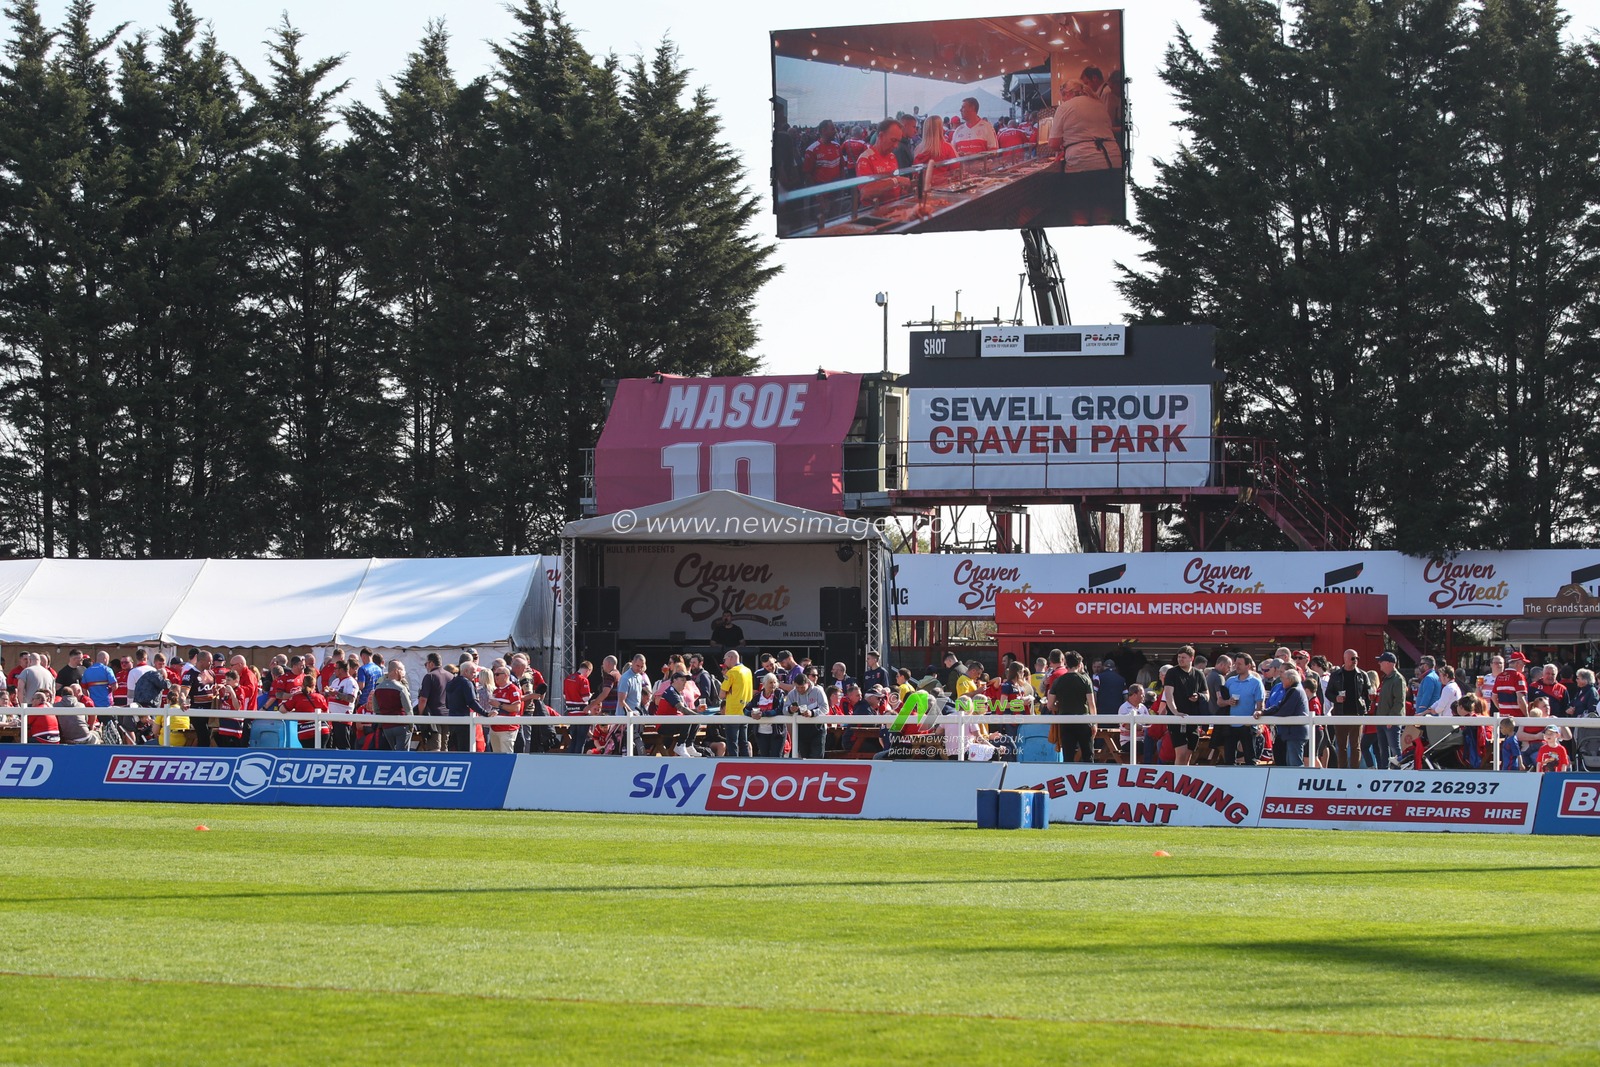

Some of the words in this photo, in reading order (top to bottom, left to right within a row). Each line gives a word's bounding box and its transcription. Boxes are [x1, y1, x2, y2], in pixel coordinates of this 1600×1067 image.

[924, 338, 946, 355] SHOT
[984, 335, 1020, 343] POLAR
[1084, 334, 1120, 342] POLAR
[660, 382, 809, 430] MASOE
[929, 396, 1062, 422] SEWELL
[1071, 394, 1189, 420] GROUP
[929, 426, 1078, 454] CRAVEN
[1090, 424, 1188, 453] PARK
[638, 546, 675, 554] PRESENTS
[673, 552, 774, 588] Craven
[954, 559, 1021, 585] Craven
[1184, 558, 1253, 584] Craven
[1424, 557, 1496, 583] Craven
[681, 582, 790, 622] Streat
[1428, 578, 1509, 609] Streat
[1075, 602, 1144, 615] OFFICIAL
[1149, 601, 1262, 615] MERCHANDISE
[1525, 603, 1541, 612] The
[1546, 602, 1600, 612] Grandstand
[116, 760, 230, 782] BETFRED
[277, 762, 355, 784] SUPER
[359, 765, 464, 788] LEAGUE
[629, 764, 706, 807] sky
[717, 772, 859, 807] sports
[1298, 779, 1347, 792] HULL
[1370, 780, 1425, 793] 07702
[1431, 781, 1500, 795] 262937
[1030, 768, 1108, 800] EVE
[1118, 768, 1249, 824] LEAMING
[1074, 802, 1178, 824] PLANT
[1266, 803, 1314, 814] SALES
[1326, 804, 1392, 816] SERVICE
[1405, 806, 1471, 818] REPAIRS
[1484, 808, 1522, 820] HIRE
